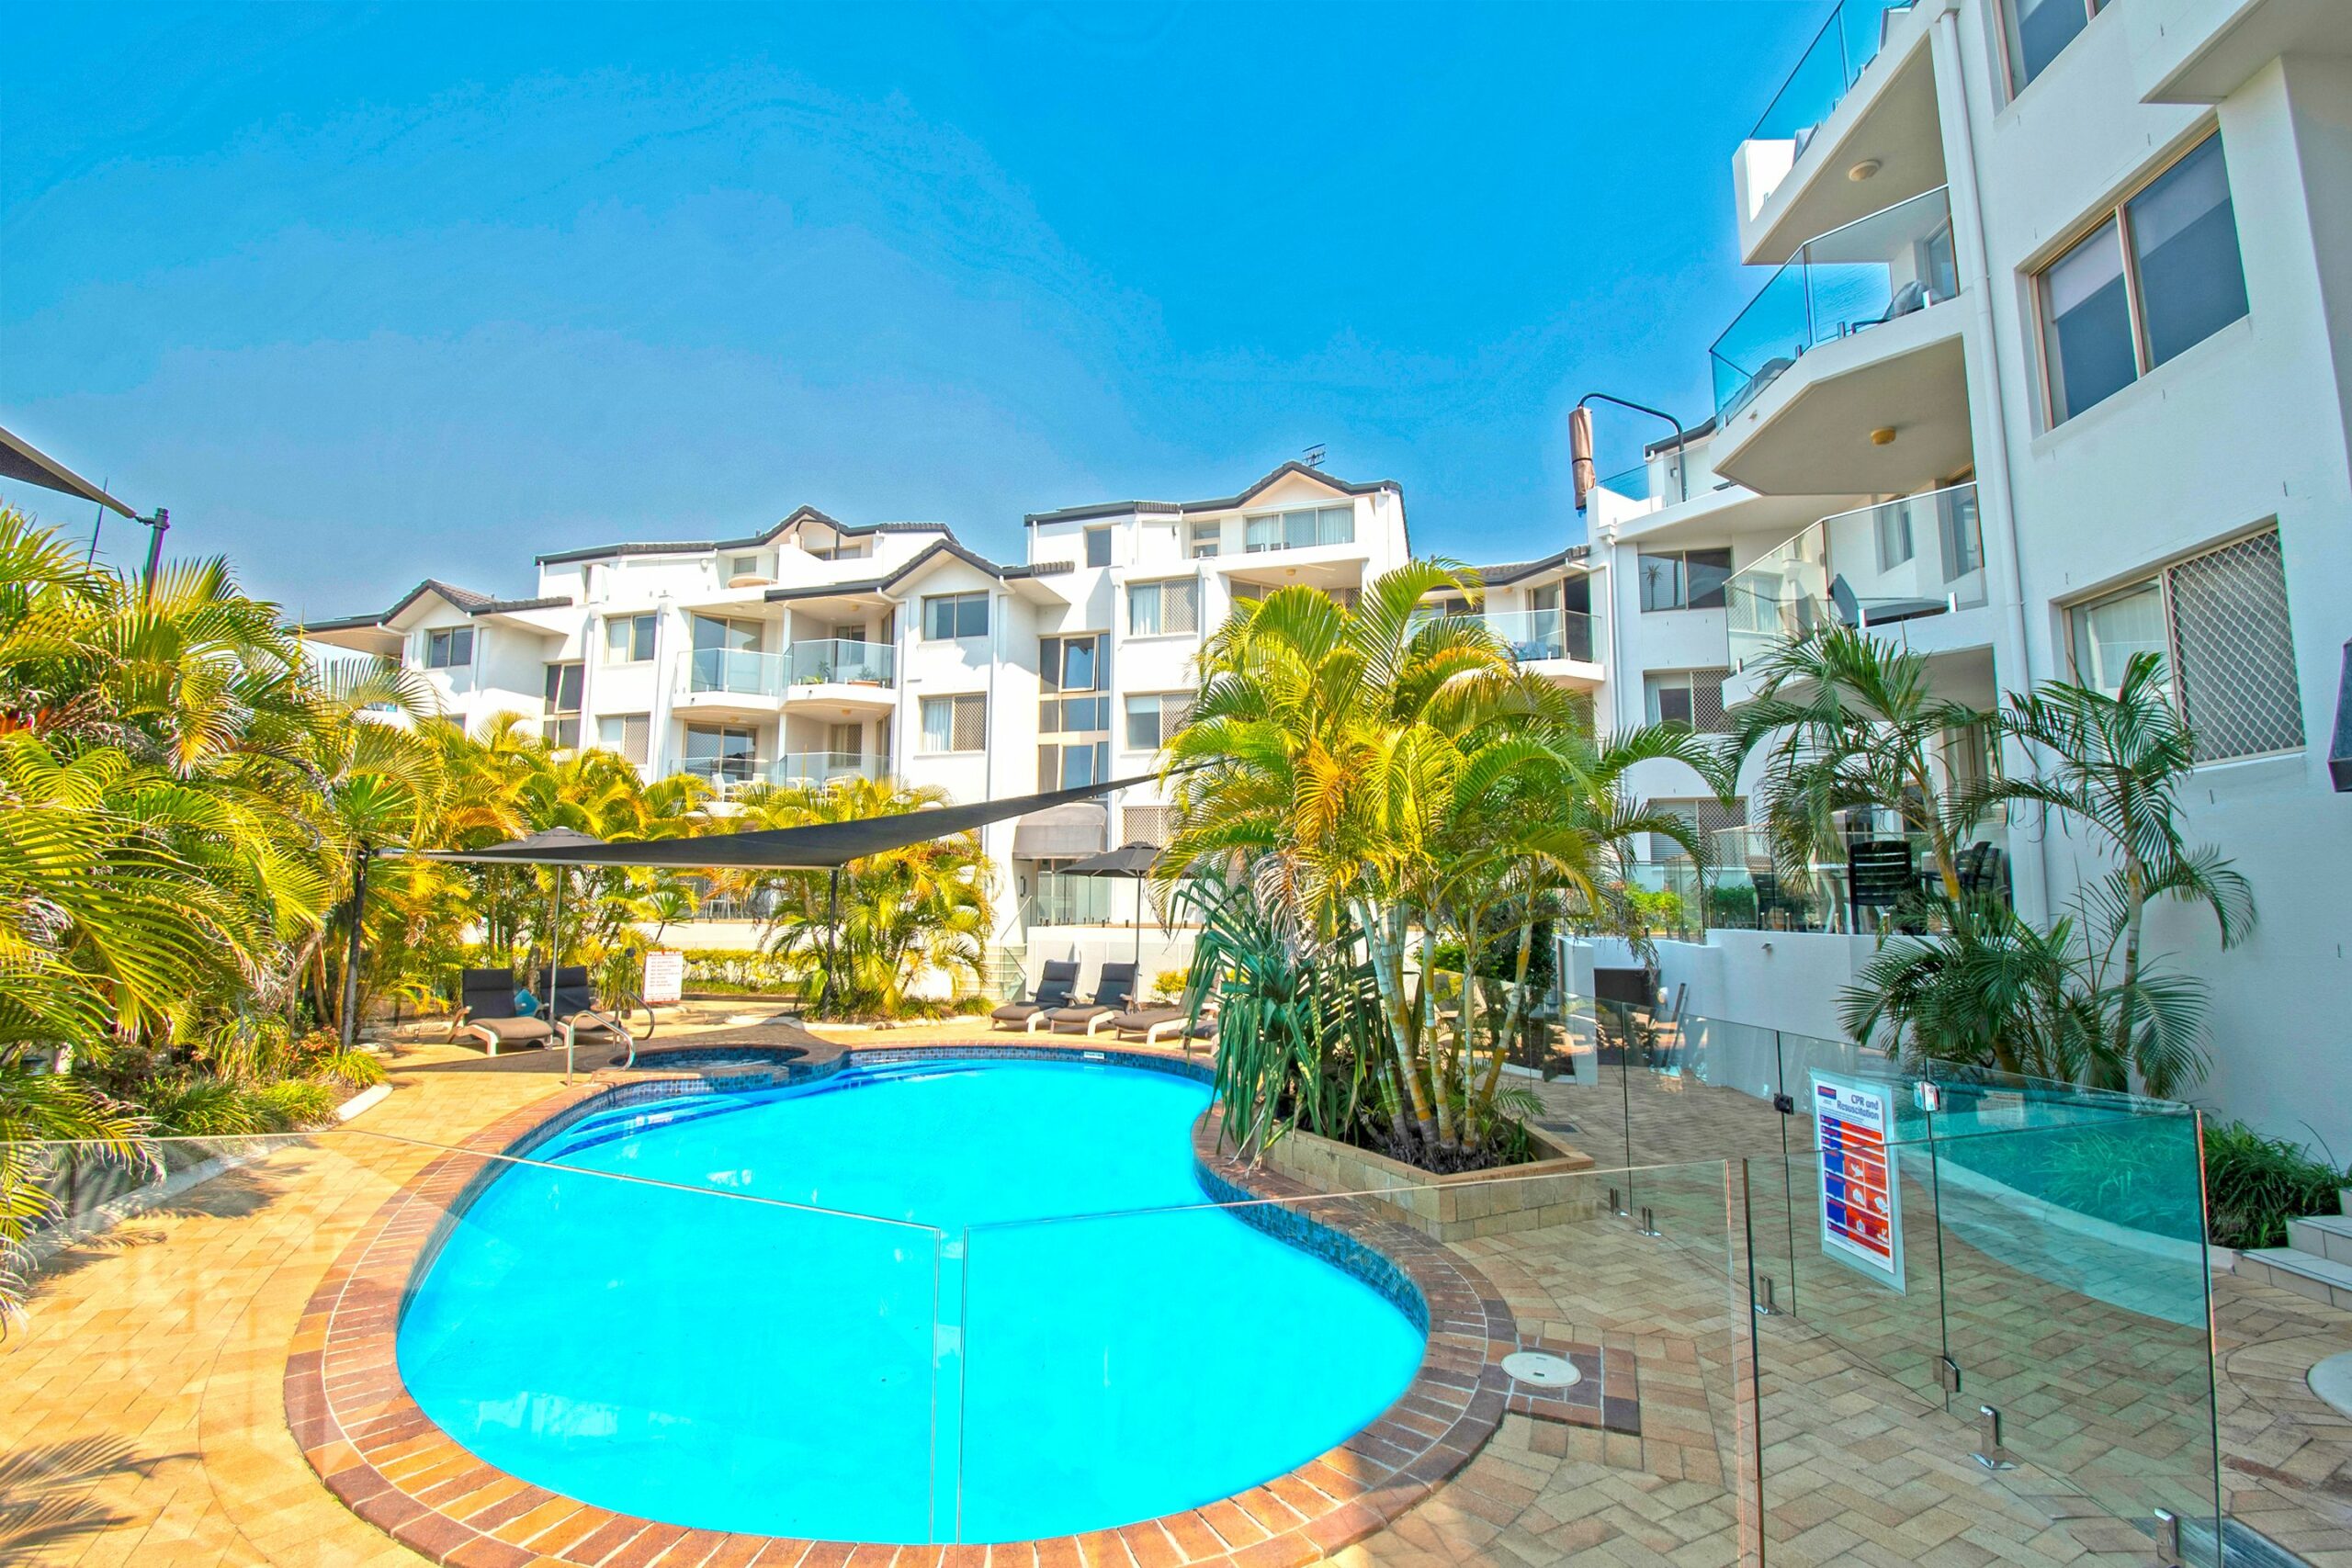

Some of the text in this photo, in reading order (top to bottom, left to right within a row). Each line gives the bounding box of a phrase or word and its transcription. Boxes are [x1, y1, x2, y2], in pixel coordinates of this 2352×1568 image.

[1837, 1100, 1879, 1120] Resuscitation
[1851, 1094, 1879, 1110] CPR and
